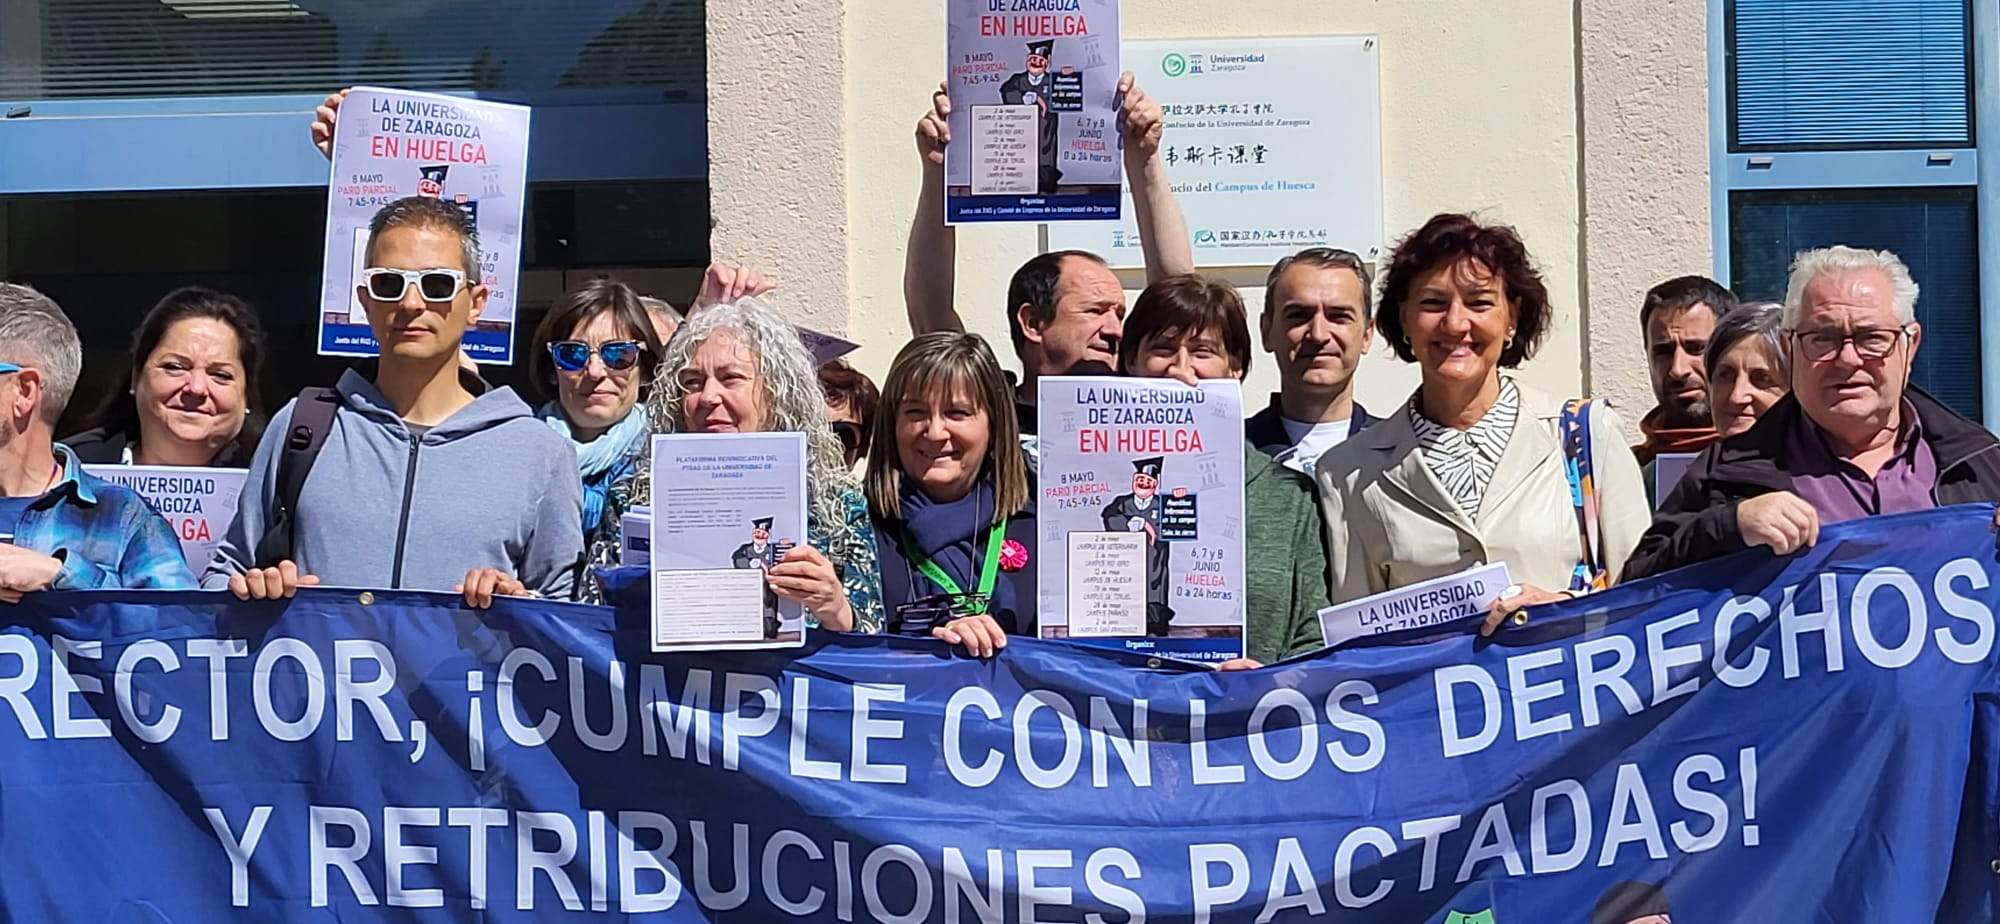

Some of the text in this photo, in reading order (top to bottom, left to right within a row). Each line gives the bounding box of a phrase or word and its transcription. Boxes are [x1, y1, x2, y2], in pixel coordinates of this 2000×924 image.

[980, 16, 1088, 36] EN HUELGA
[971, 52, 994, 63] MAYO
[1210, 54, 1265, 64] Universidad
[953, 62, 1009, 76] PARO PARCIAL
[372, 98, 391, 114] LA
[381, 117, 481, 139] DE ZARAGOZA
[1086, 118, 1092, 126] 7
[1207, 120, 1215, 128] la
[1216, 119, 1263, 128] Universidad
[1276, 118, 1311, 127] Zaragoza
[1078, 129, 1103, 139] JUNIO
[371, 136, 487, 164] EN HUELGA
[1071, 140, 1106, 151] HUELGA
[1077, 152, 1088, 161] 24
[1089, 152, 1113, 163] horas
[359, 173, 384, 184] MAYO
[337, 185, 398, 195] PARO PARCIAL
[1168, 181, 1316, 194] ucio del Campus de Huesca
[479, 262, 495, 273] NIO
[480, 276, 498, 285] LGA
[489, 289, 505, 299] ras
[1077, 388, 1205, 405] LA UNIVERSIDAD
[1088, 408, 1194, 425] DE ZARAGOZA
[1080, 429, 1203, 453] EN HUELGA
[1061, 471, 1094, 484] 8 MAYO
[1045, 482, 1112, 497] PARO PARCIAL
[143, 496, 203, 514] AGOZA
[1201, 548, 1208, 557] 7
[1209, 550, 1216, 559] y
[1217, 549, 1224, 559] 8
[1192, 561, 1221, 572] JUNIO
[1184, 573, 1226, 586] HUELGA
[1176, 586, 1232, 600] 0 a 24 horas
[1358, 580, 1486, 626] LA UNIVERSIDAD
[0, 556, 1996, 789] RECTOR, ¡CUMPLE CON LOS DERECHOS
[202, 746, 1761, 924] Y RETRIBUCIONES PACTADAS!
